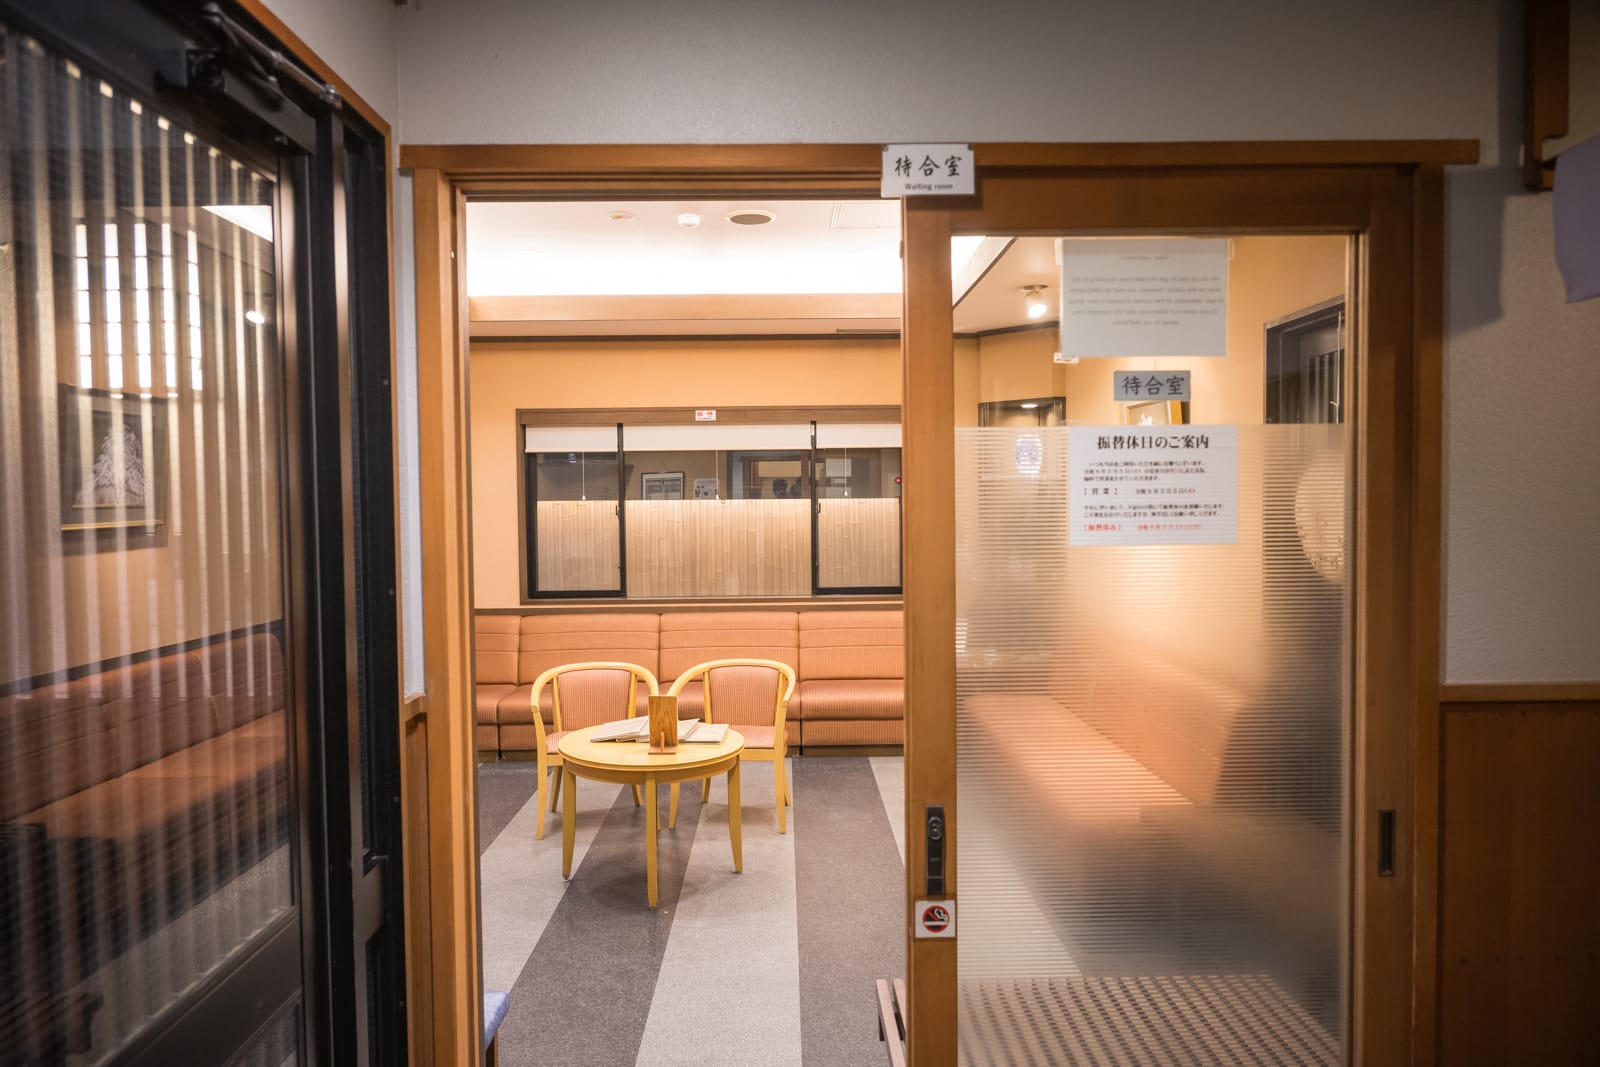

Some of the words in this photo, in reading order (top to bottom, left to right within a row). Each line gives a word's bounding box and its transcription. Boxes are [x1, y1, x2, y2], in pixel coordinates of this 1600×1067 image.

[894, 154, 962, 178] 待合室
[905, 183, 932, 191] Waiting
[1122, 375, 1185, 396] 待合室
[1097, 434, 1209, 450] 振替休日のご案内
